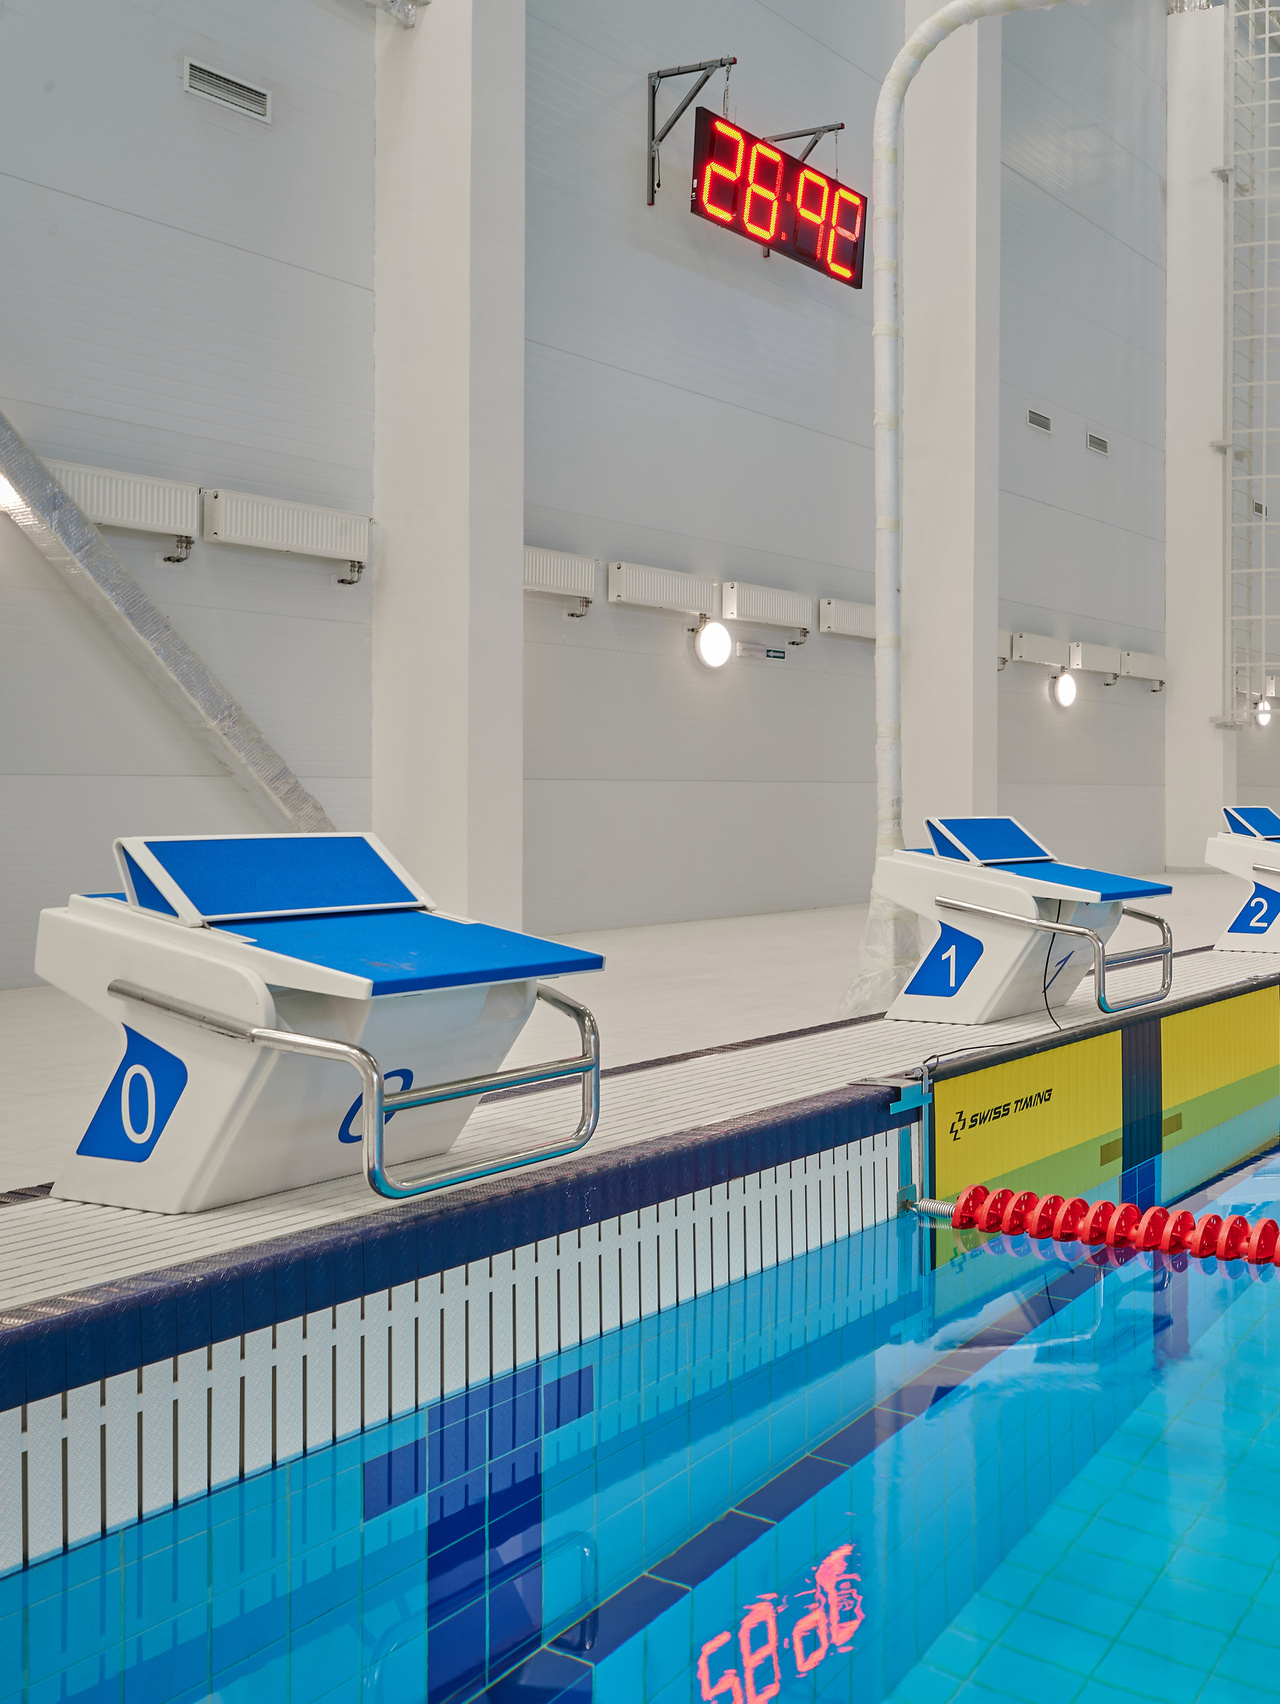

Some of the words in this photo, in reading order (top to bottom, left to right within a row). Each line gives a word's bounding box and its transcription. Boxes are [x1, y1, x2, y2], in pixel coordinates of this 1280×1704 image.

[1250, 897, 1268, 928] 2
[941, 944, 956, 988] 1
[121, 1064, 156, 1144] 0
[968, 1102, 1011, 1129] SWISS
[1013, 1088, 1053, 1113] TIMING
